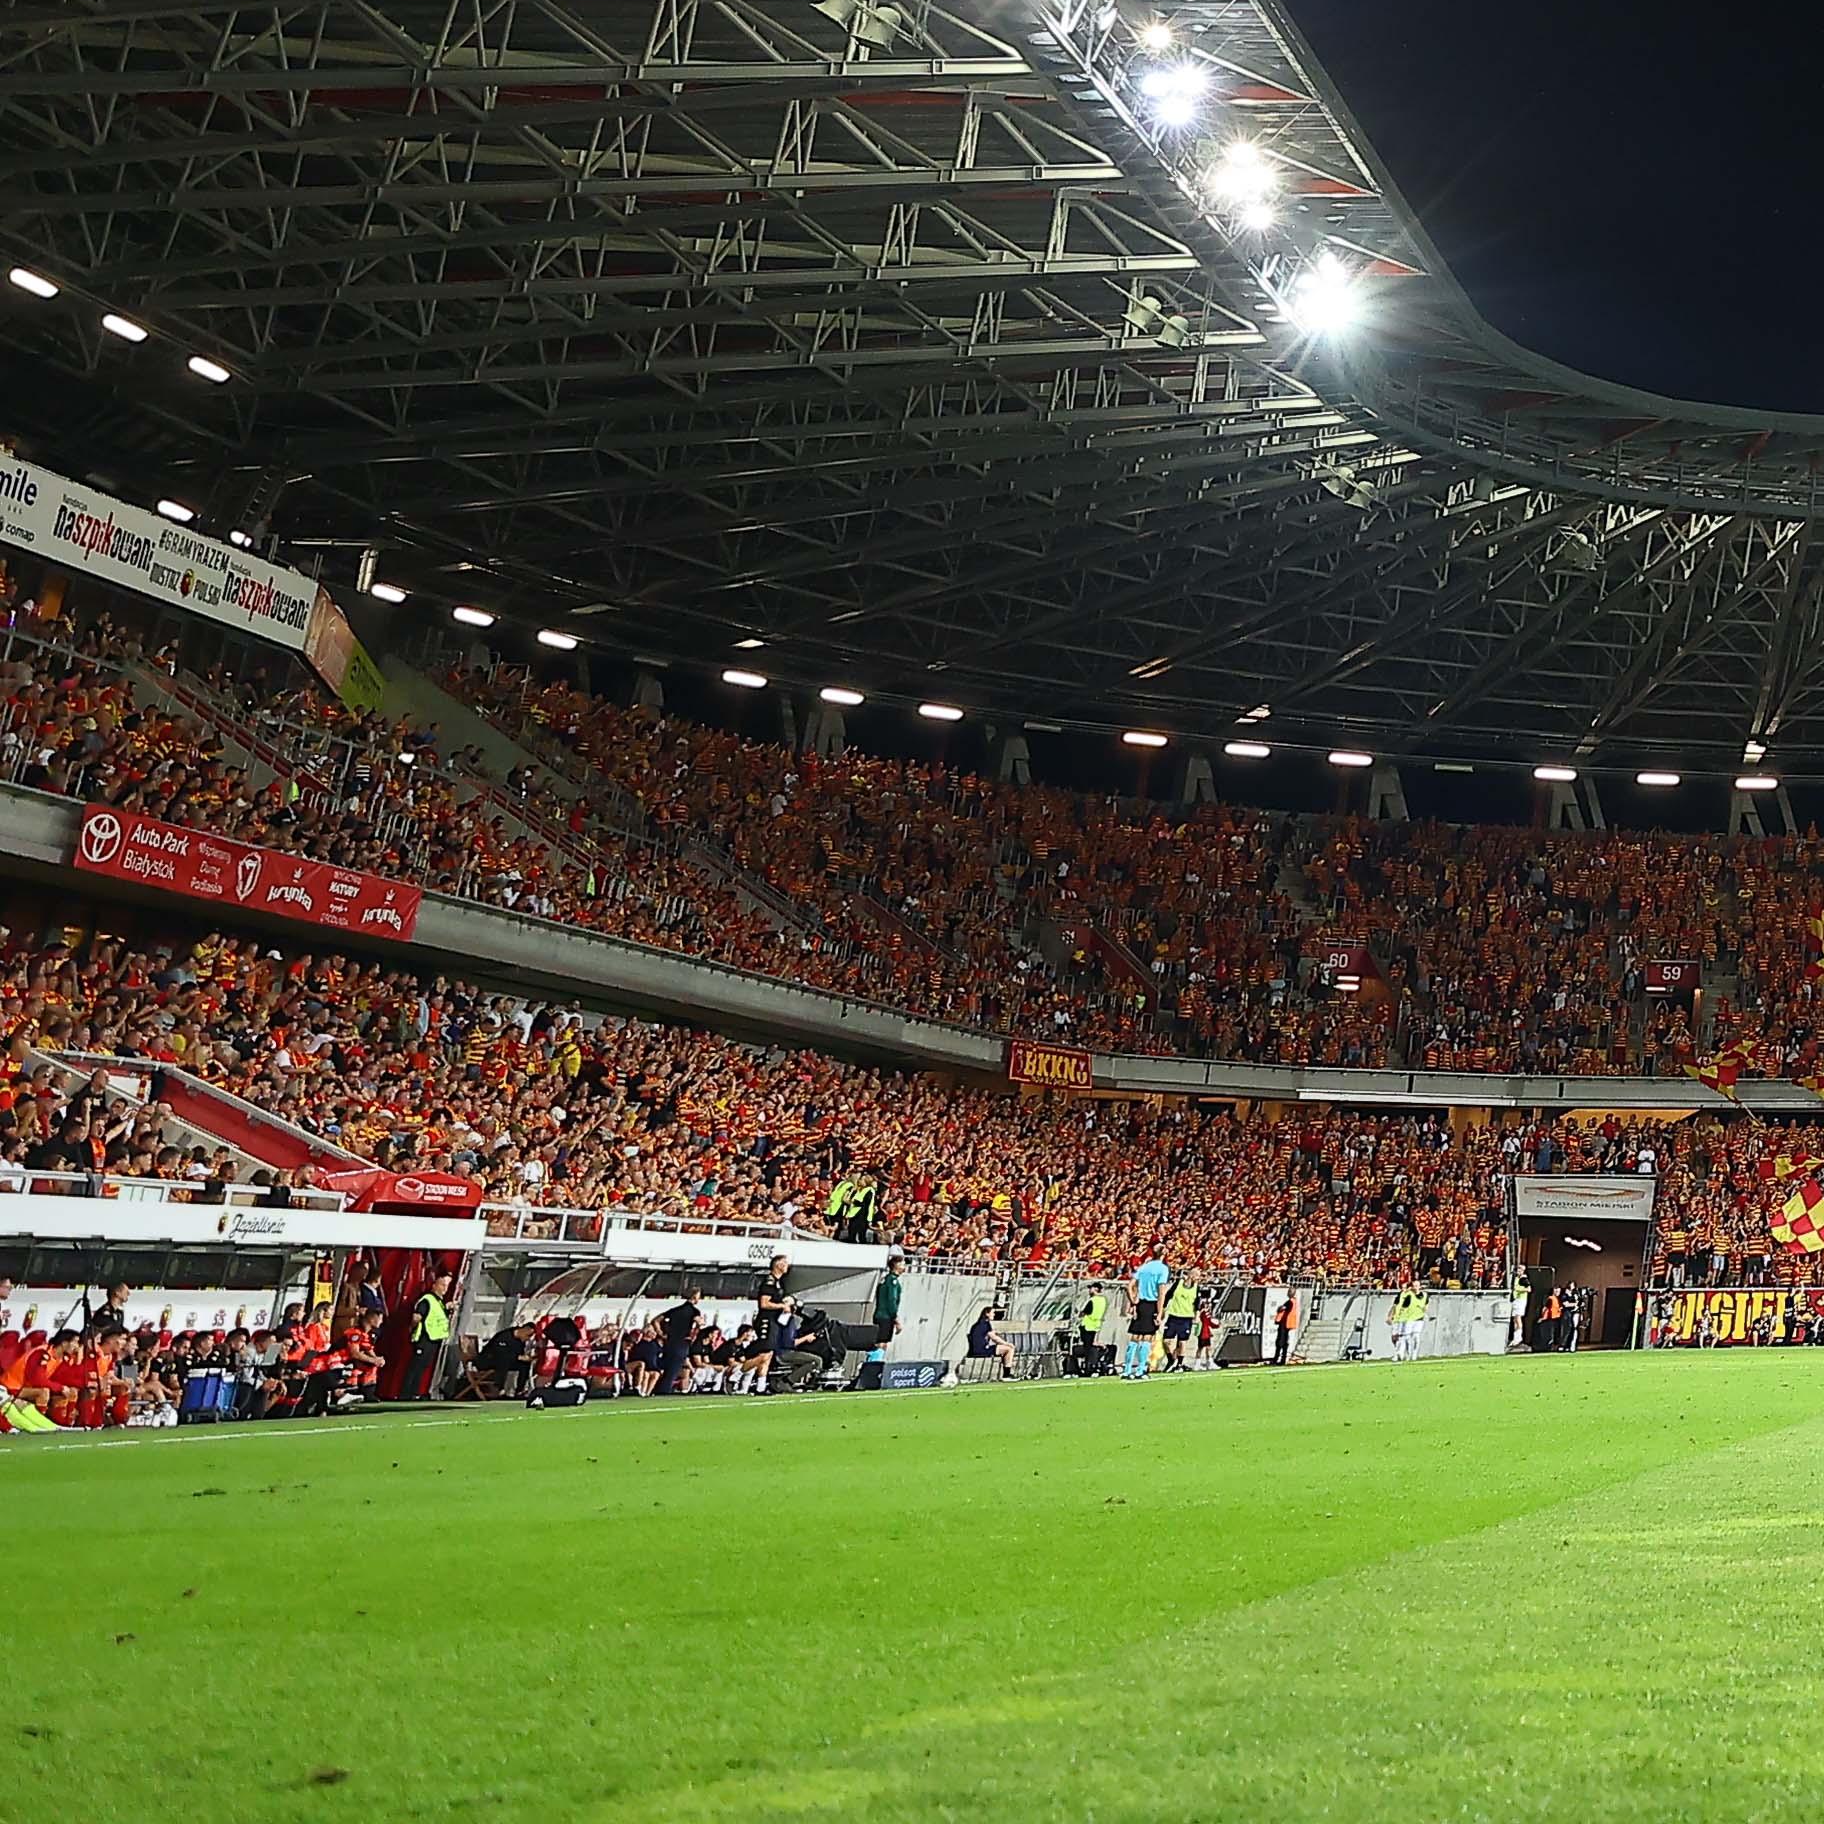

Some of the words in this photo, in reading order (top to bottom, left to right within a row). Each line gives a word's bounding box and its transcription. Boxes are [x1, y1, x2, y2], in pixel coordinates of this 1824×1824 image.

[131, 823, 160, 848] Auto
[161, 830, 190, 857] Park
[1329, 952, 1349, 969] 60
[1661, 965, 1682, 981] 59
[890, 1369, 916, 1379] polsat
[894, 1378, 915, 1388] sport
